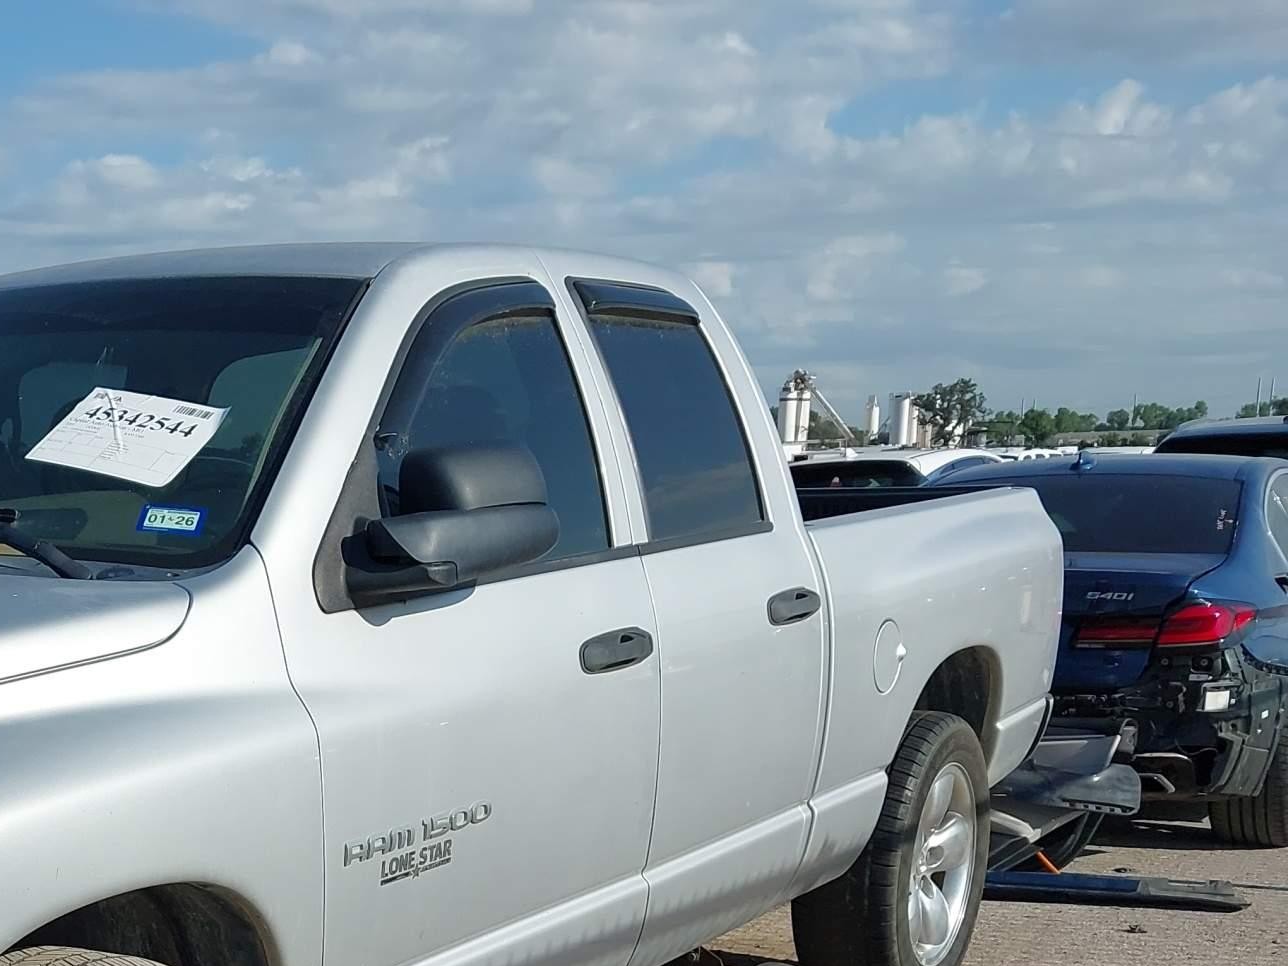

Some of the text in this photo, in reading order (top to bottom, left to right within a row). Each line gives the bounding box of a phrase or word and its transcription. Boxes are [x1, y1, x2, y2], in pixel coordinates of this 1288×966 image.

[84, 405, 199, 438] 45342544
[343, 801, 491, 867] RAM 1500
[380, 838, 452, 879] LONE STAR
